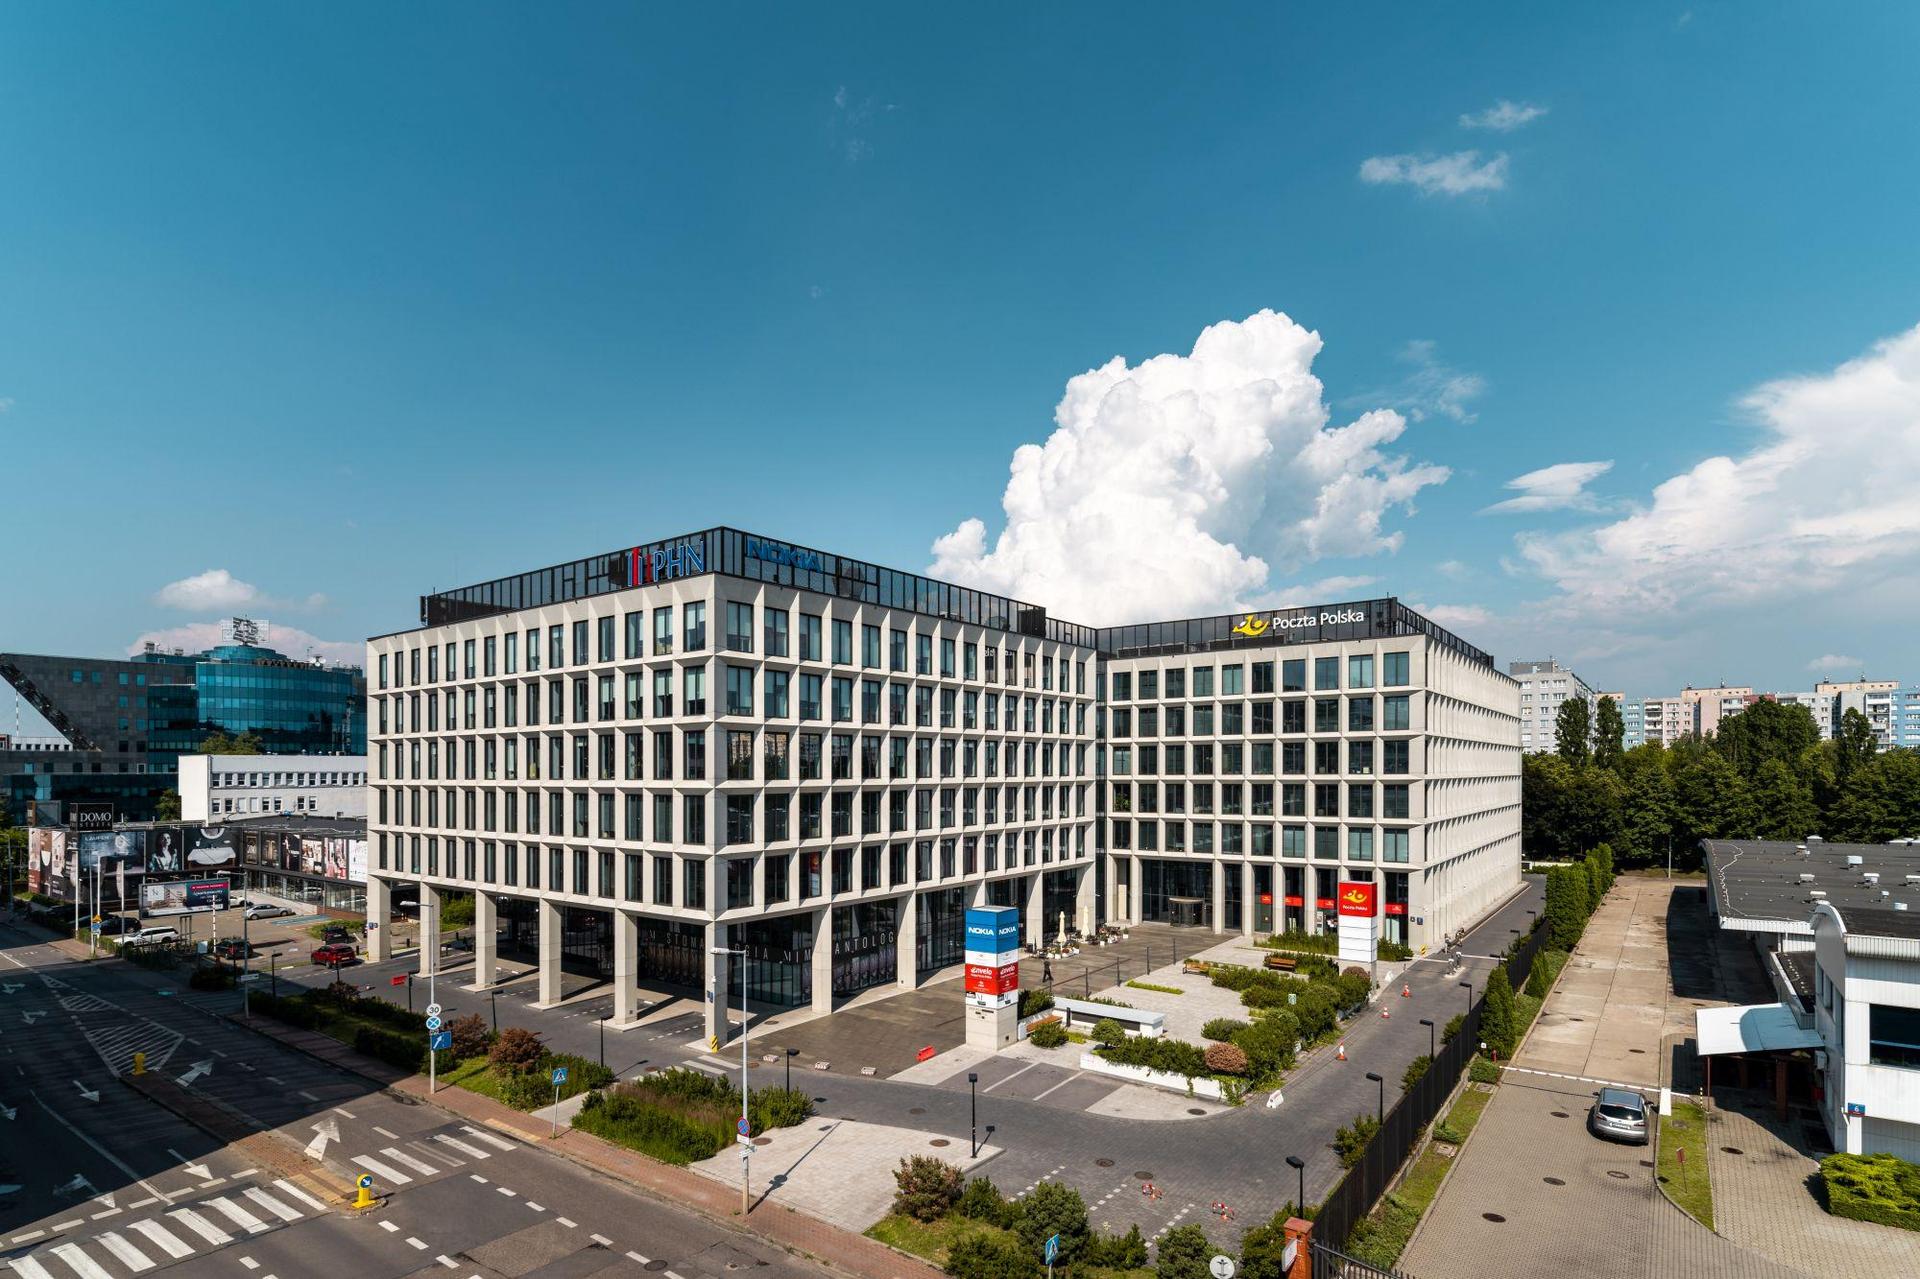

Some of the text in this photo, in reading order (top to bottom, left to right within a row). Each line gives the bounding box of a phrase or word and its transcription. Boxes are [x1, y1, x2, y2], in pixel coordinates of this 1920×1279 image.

[653, 540, 705, 580] PHN
[747, 540, 821, 573] NOKIA
[1273, 609, 1364, 630] Poczta Polska
[80, 812, 112, 822] DOMO
[968, 926, 994, 936] NOKIA
[998, 926, 1017, 936] NOKIA
[429, 1006, 440, 1014] 30
